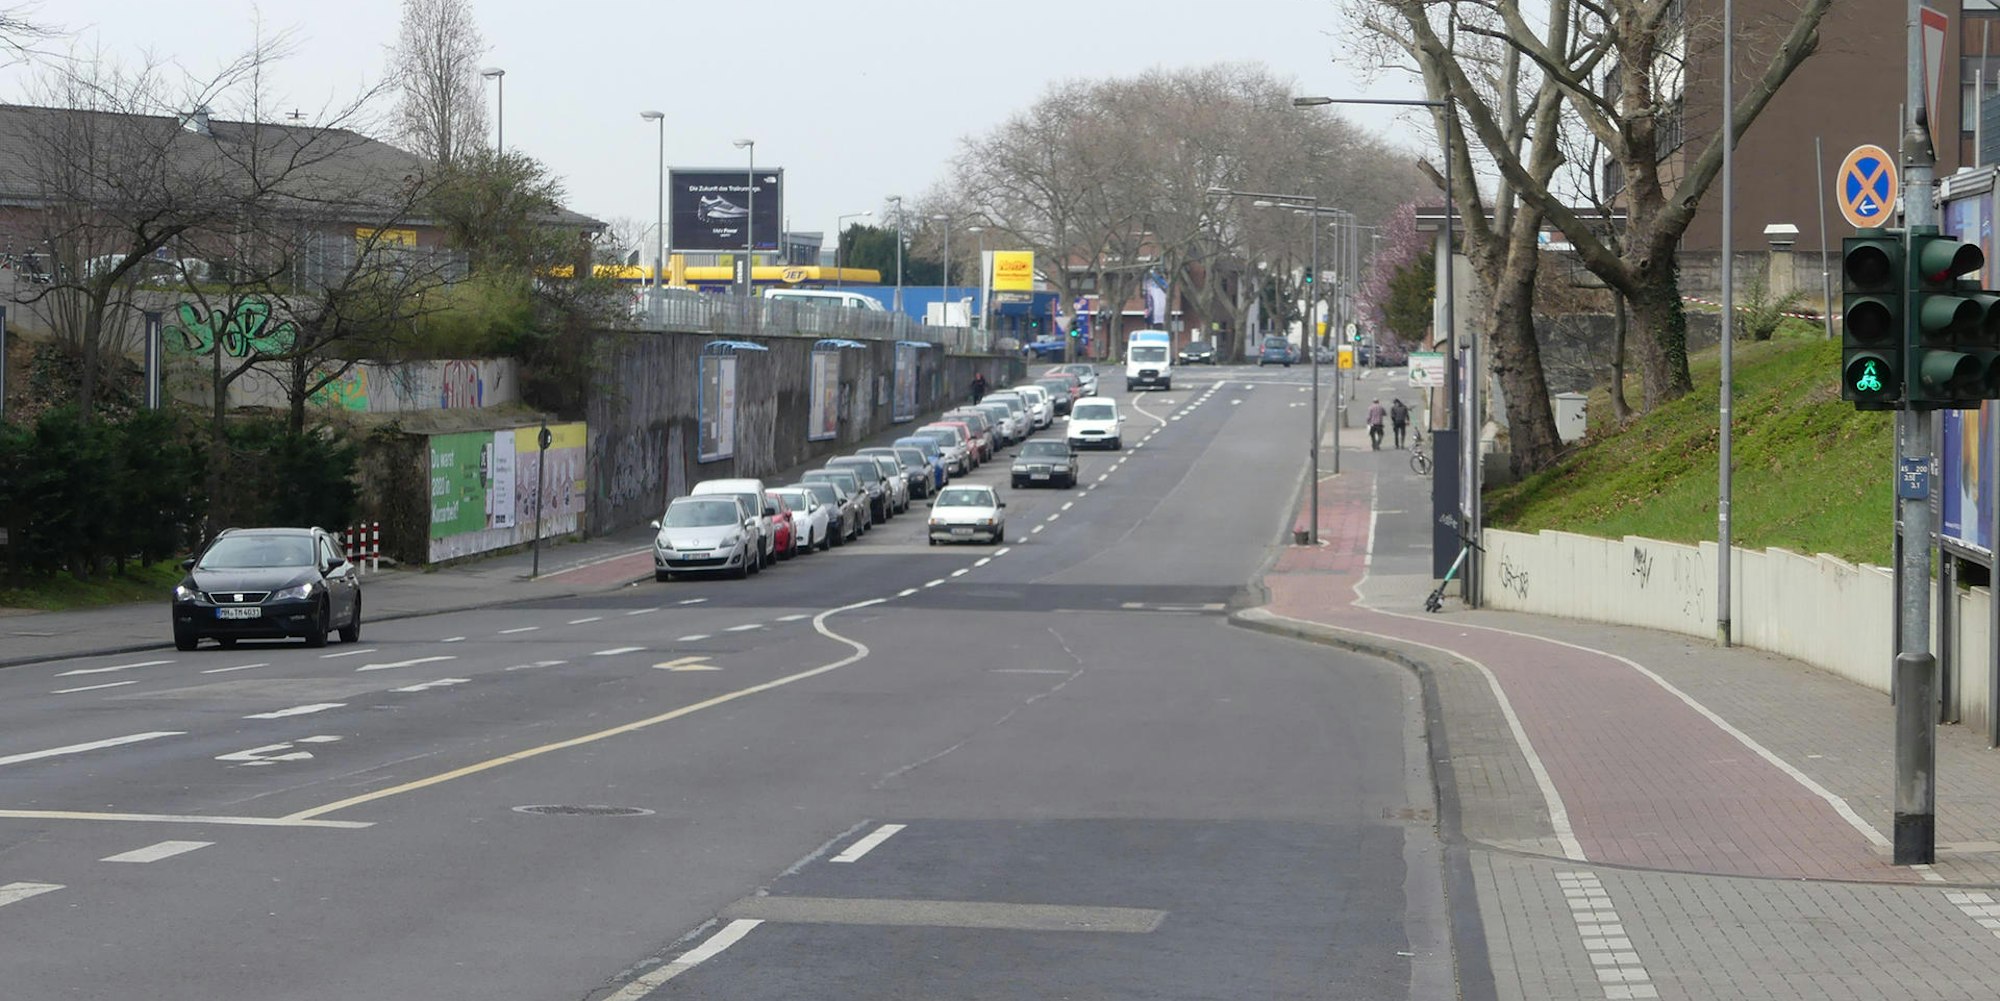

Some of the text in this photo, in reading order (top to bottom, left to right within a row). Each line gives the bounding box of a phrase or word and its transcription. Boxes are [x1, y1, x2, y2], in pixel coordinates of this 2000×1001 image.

[785, 271, 804, 279] JET
[431, 449, 439, 469] Du
[1915, 465, 1928, 473] 200
